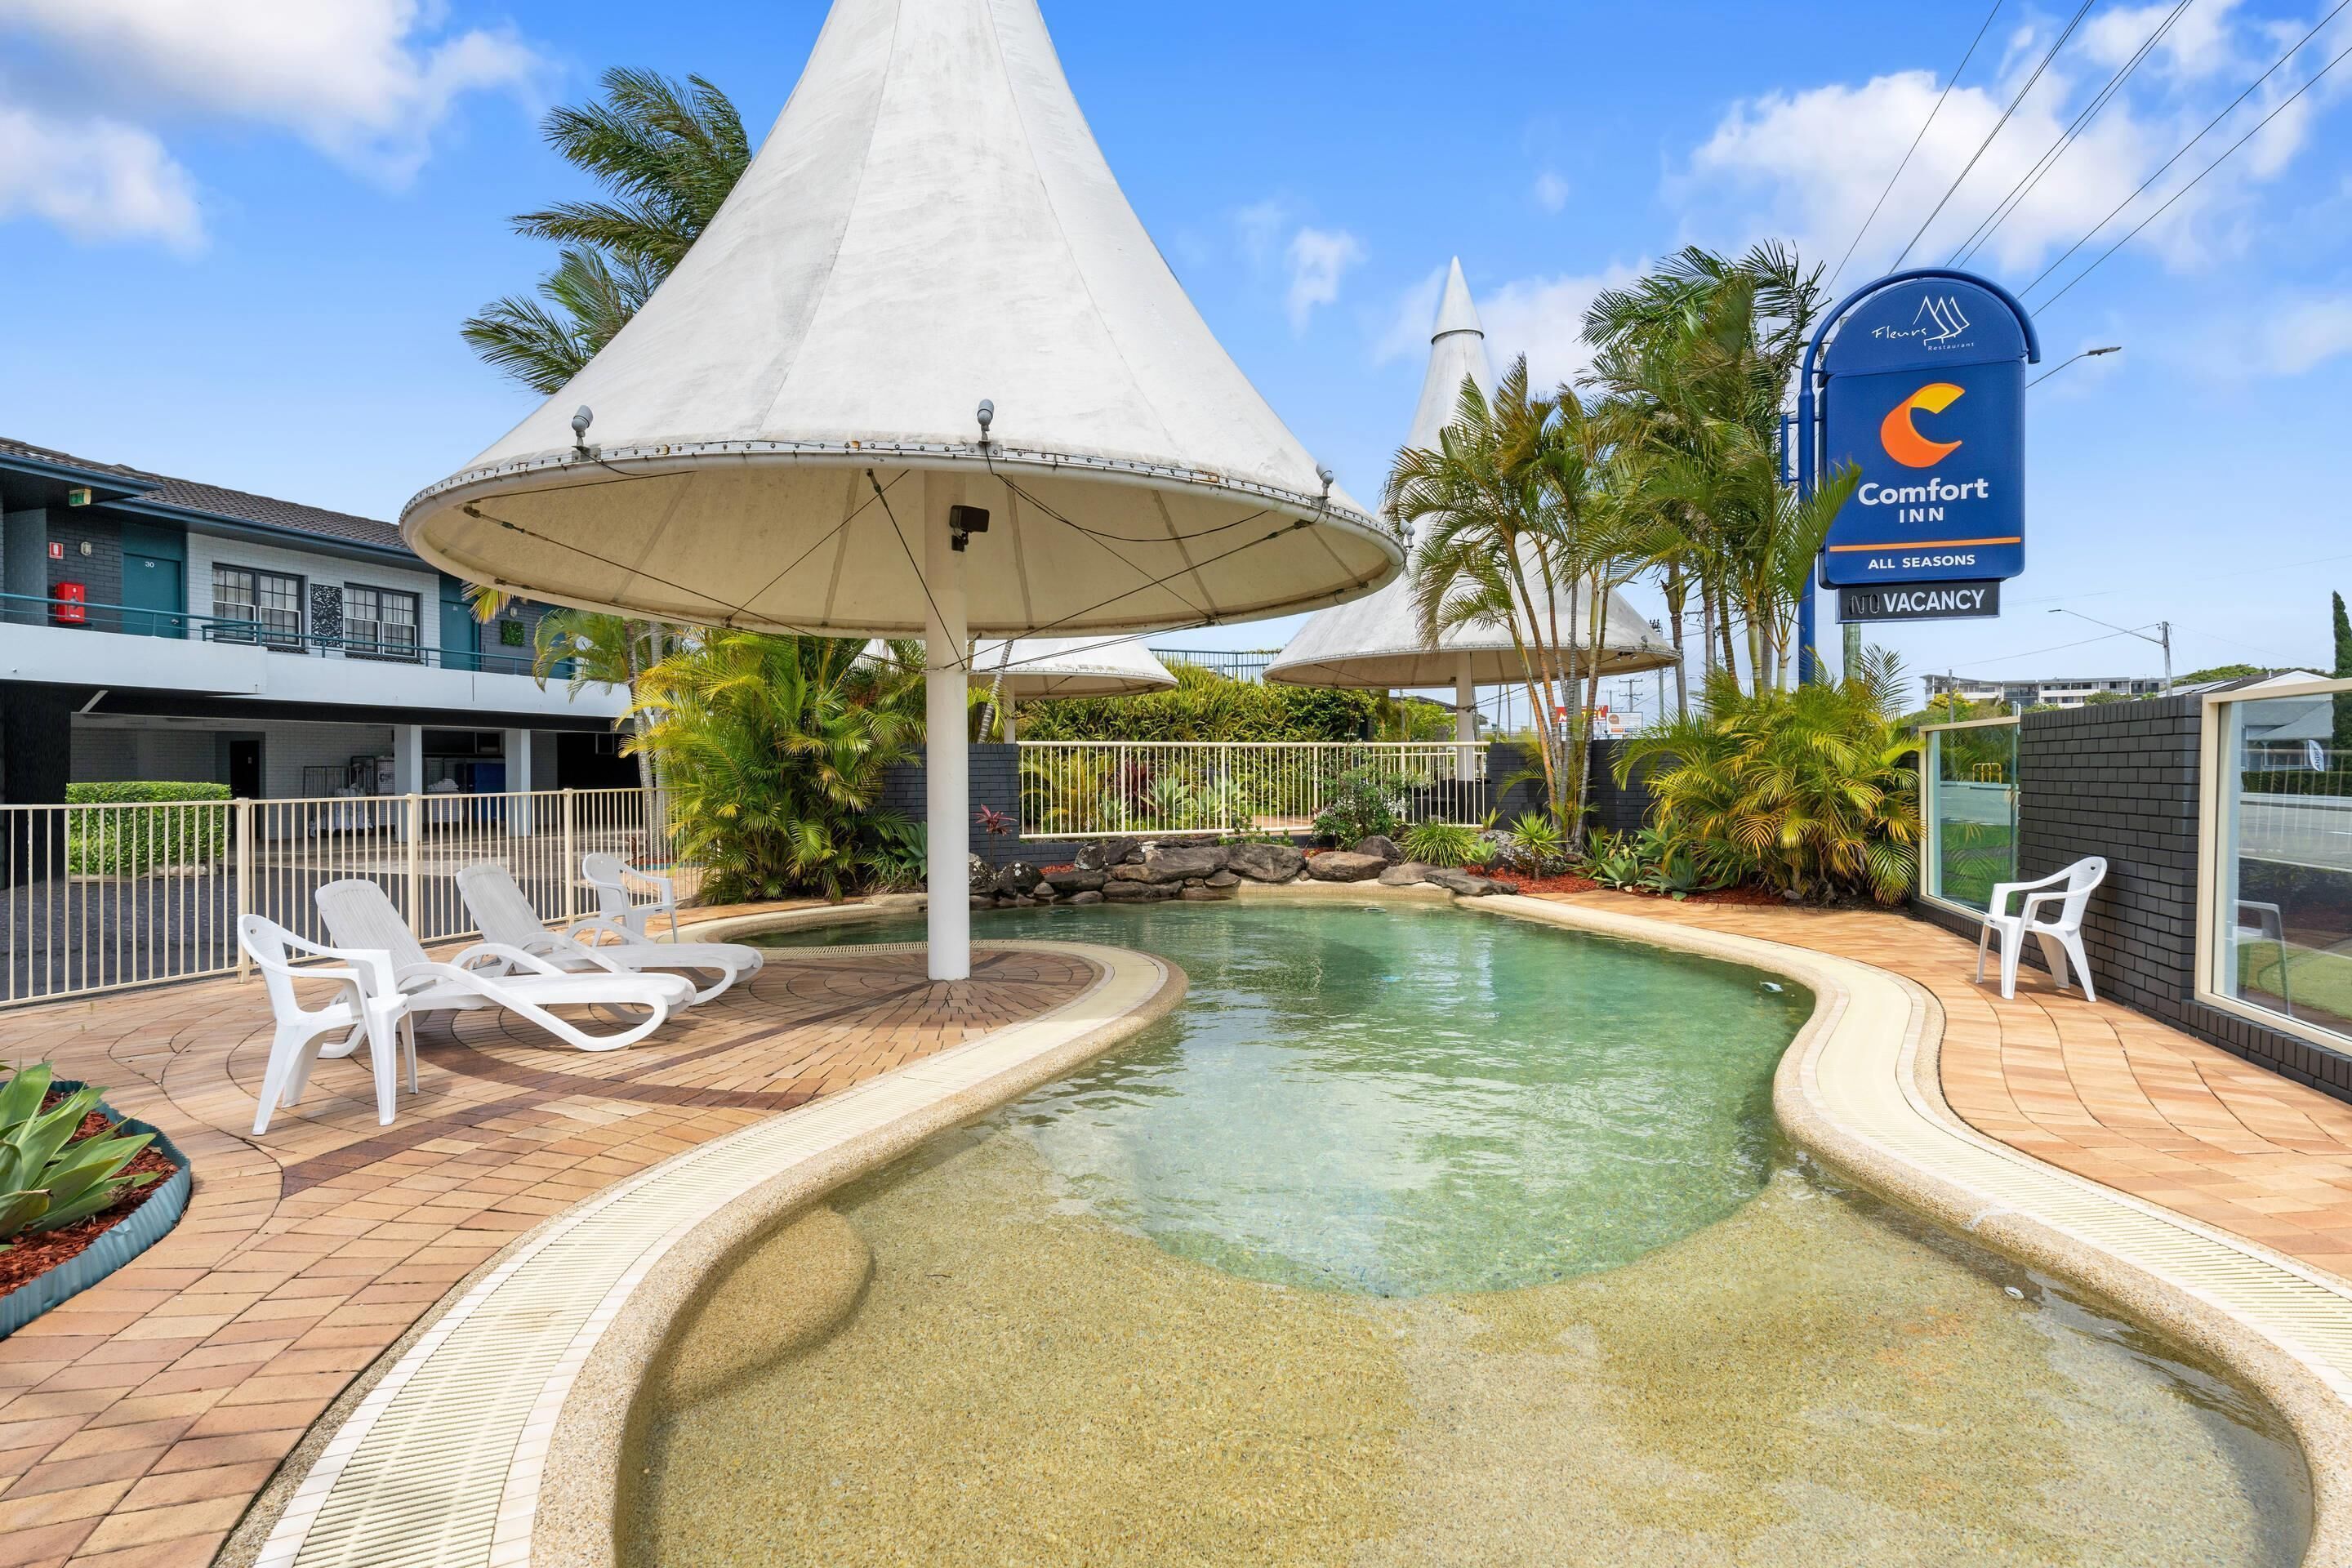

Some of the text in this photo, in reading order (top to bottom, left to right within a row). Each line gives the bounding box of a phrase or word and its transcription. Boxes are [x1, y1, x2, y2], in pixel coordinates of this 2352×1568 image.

[1871, 325, 1927, 339] Fleurs
[1927, 342, 1975, 351] Restaurant
[1858, 478, 1989, 506] Comfort
[1900, 507, 1944, 523] INN
[1868, 555, 1976, 569] ALL SEASONS
[1850, 589, 1985, 614] NO VACANCY
[1559, 710, 1606, 721] MTL
